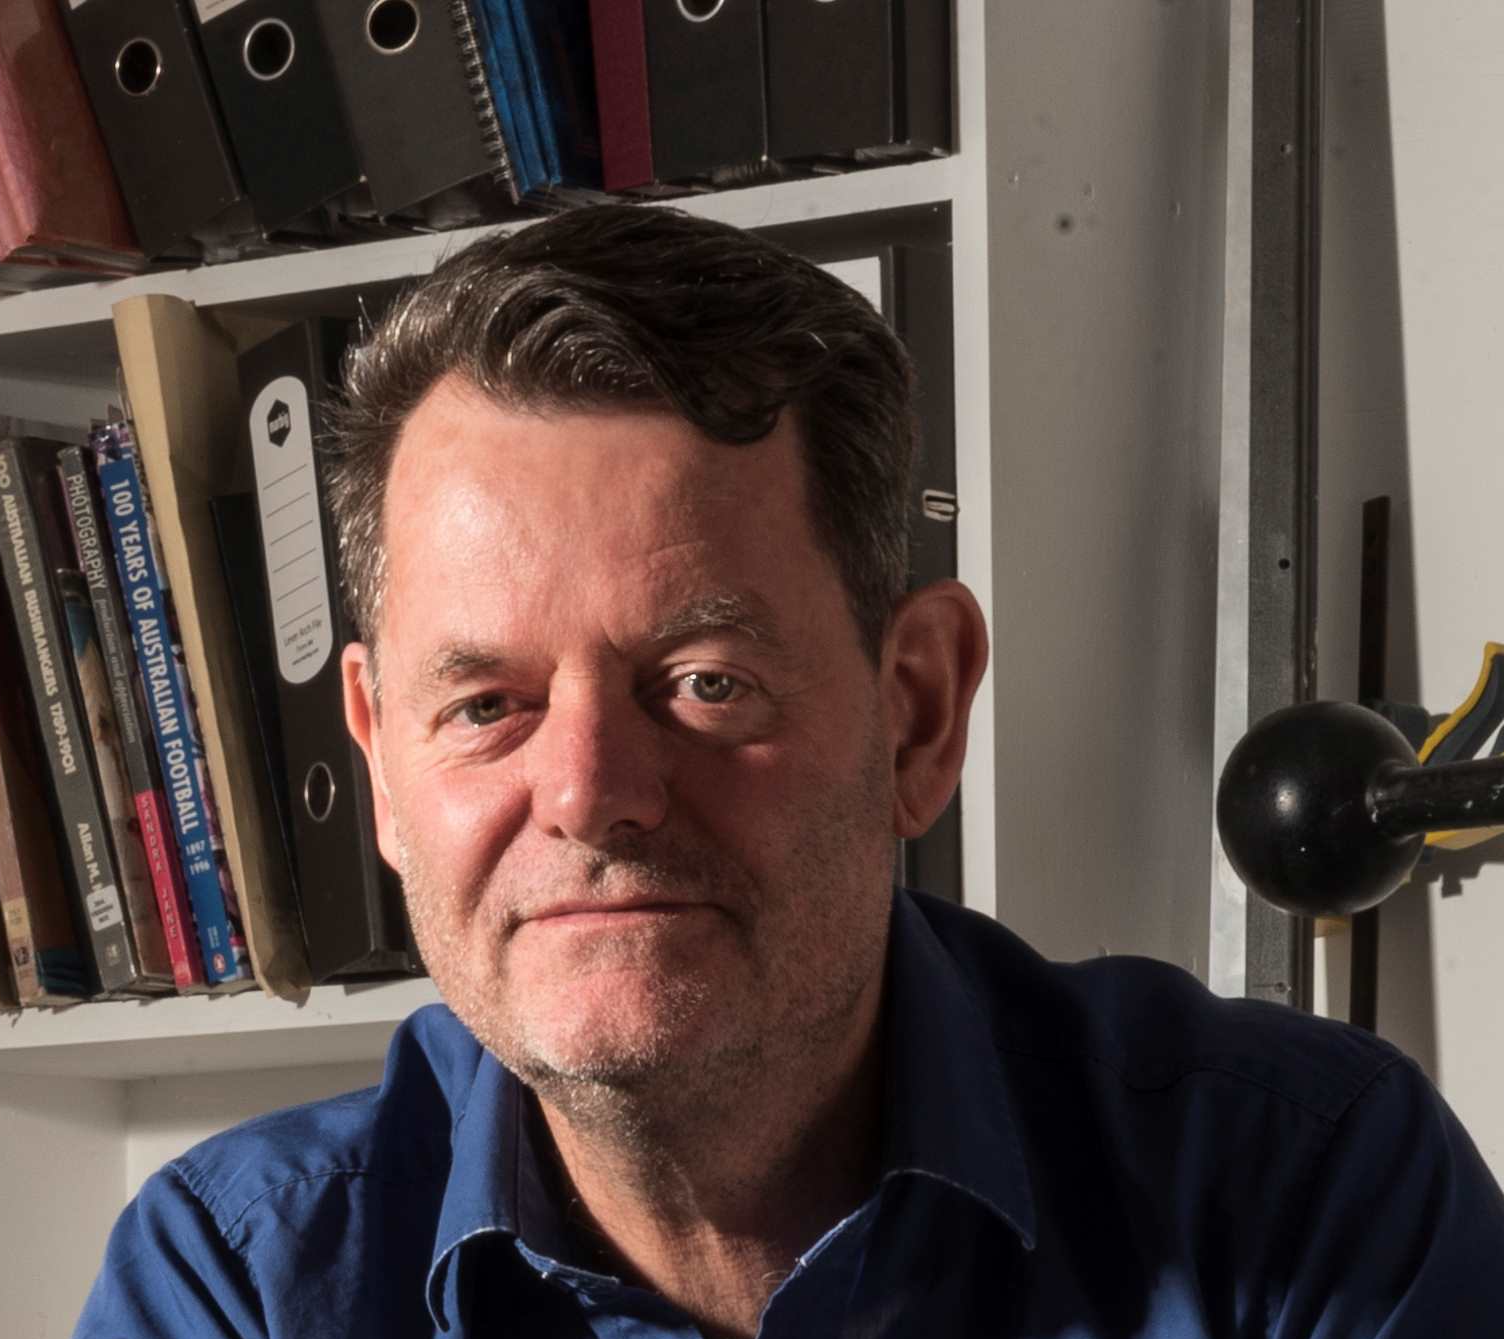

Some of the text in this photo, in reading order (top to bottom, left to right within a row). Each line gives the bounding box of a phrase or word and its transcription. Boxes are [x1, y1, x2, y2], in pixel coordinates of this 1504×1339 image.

[2, 494, 34, 585] AUSTRALIAN
[24, 589, 59, 697] BUSHRANGERS
[49, 702, 78, 775] 1789-1901
[67, 474, 108, 590] PHOTOGRAPHY
[96, 598, 117, 652] production
[113, 680, 136, 744] appreciation
[110, 479, 200, 835] 100 YEARS OF AUSTRALIAN FOOTBALL
[77, 823, 95, 862] Allan
[186, 840, 206, 856] 1897
[190, 860, 210, 875] 1996
